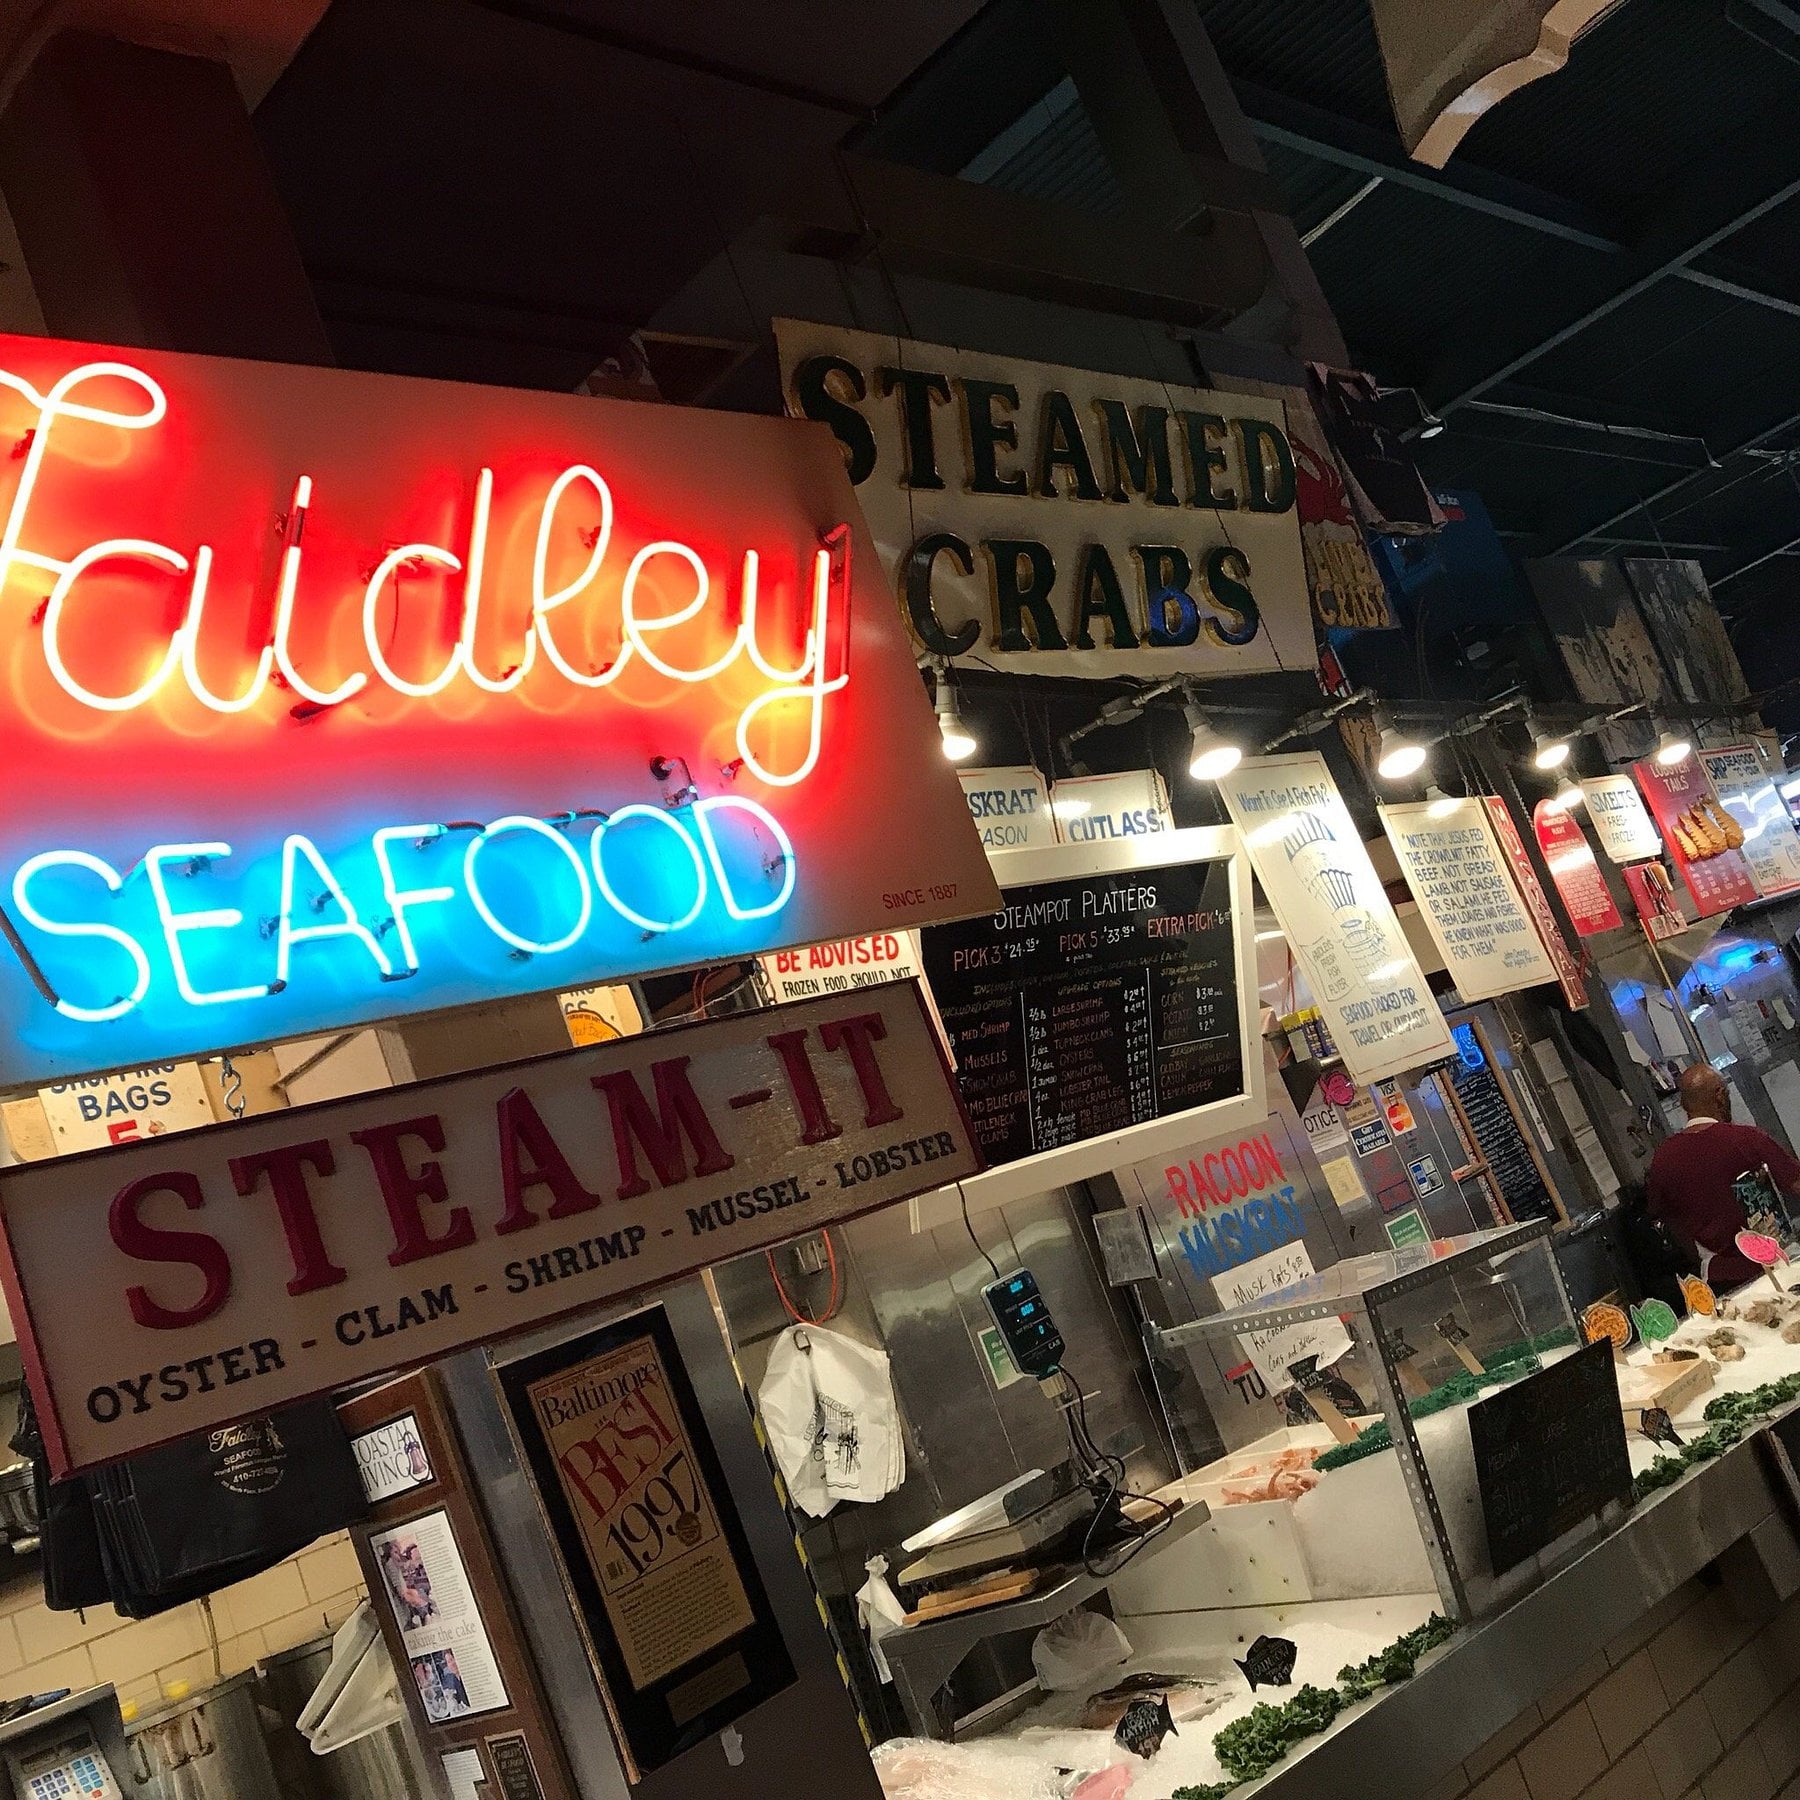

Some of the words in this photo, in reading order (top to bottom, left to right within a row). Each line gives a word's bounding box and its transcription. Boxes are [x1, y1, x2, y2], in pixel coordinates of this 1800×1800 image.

[798, 355, 1297, 514] STEAMED
[0, 362, 849, 786] Faidley
[905, 532, 1258, 656] CRABS
[1663, 775, 1689, 793] TAILS
[964, 788, 1037, 818] SKRAT
[1590, 789, 1637, 813] SMELTS
[1607, 814, 1628, 828] FRES
[977, 825, 1028, 846] ASON
[1469, 828, 1484, 841] FED
[1405, 851, 1424, 866] THE
[1465, 844, 1491, 860] FATTY
[1441, 865, 1460, 879] NOT
[1463, 860, 1498, 876] GREASY
[882, 889, 926, 909] SINCE
[929, 884, 959, 901] 1887
[1450, 880, 1469, 893] NOT
[1470, 875, 1506, 892] SAUSAGE
[13, 794, 796, 1023] SEAFOOD
[994, 898, 1071, 930] STEAMPOT
[1082, 886, 1156, 918] PLATTERS
[1428, 900, 1443, 914] OR
[1492, 890, 1510, 903] FED
[1147, 916, 1186, 938] EXTRA
[1187, 912, 1214, 932] PICK
[1456, 909, 1485, 924] LOAVES
[1472, 924, 1493, 940] WHAT
[1494, 921, 1511, 935] WAS
[1508, 918, 1527, 933] GOOD
[776, 951, 802, 973] BE
[809, 935, 899, 969] ADVISED
[1060, 933, 1087, 952] PICK
[1090, 931, 1098, 948] 5
[1450, 944, 1472, 960] FOR
[954, 947, 988, 971] PICK
[990, 945, 1001, 964] 3
[782, 979, 820, 998] FROZEN
[825, 975, 848, 991] FOOD
[892, 966, 911, 980] NOT
[1399, 987, 1419, 1005] FOR
[1350, 1024, 1383, 1047] TRAVEL
[964, 1049, 1008, 1070] MUSSELS
[77, 1080, 172, 1121] BAGS
[108, 1012, 904, 1330] STEAM-IT
[1165, 1133, 1288, 1220] RACOON
[1179, 1185, 1307, 1281] MUSKRAT
[87, 1337, 286, 1424] OYSTER
[335, 1283, 459, 1347] CLAM
[505, 1223, 647, 1294] SHRIMP
[685, 1175, 811, 1236] MUSSEL
[834, 1130, 958, 1188] LOBSTER
[541, 1363, 657, 1428] Baltimore
[1232, 1368, 1267, 1405] TU
[559, 1374, 681, 1526] BEST
[358, 1452, 410, 1494] IVING
[605, 1450, 699, 1577] 1997
[437, 1626, 453, 1642] the
[455, 1621, 477, 1636] cake
